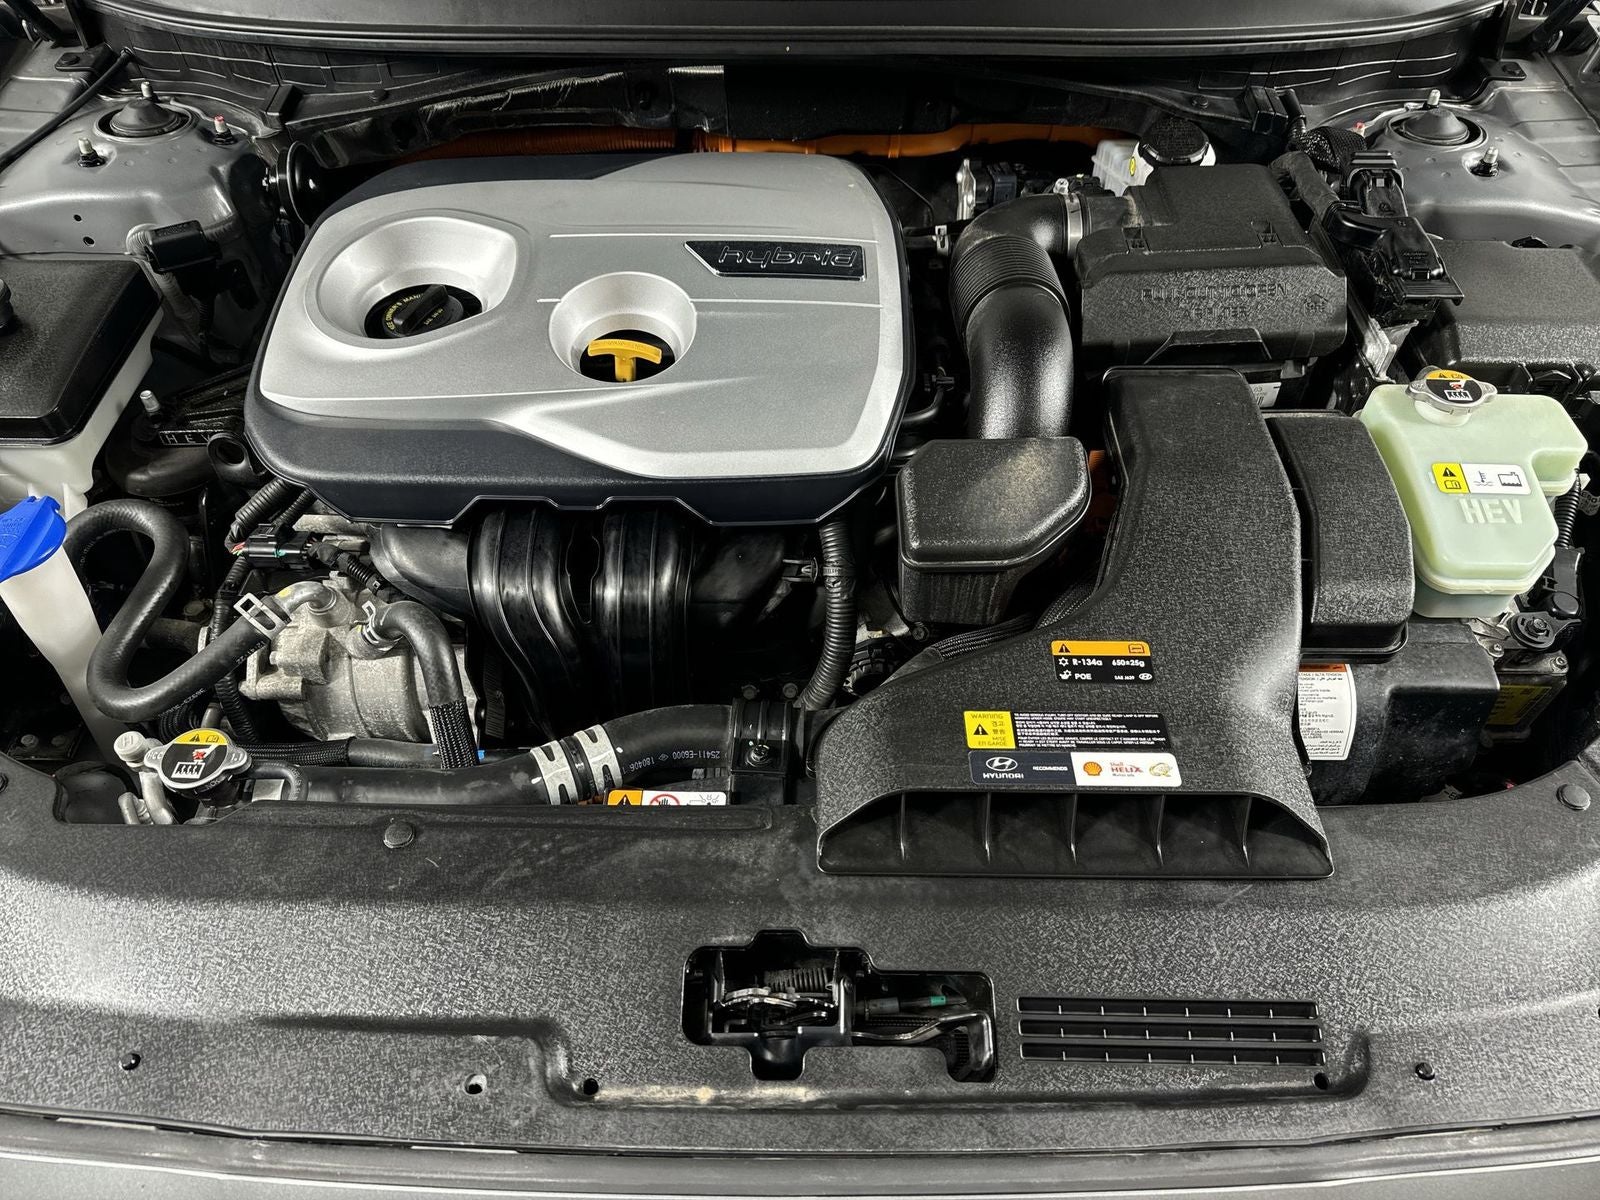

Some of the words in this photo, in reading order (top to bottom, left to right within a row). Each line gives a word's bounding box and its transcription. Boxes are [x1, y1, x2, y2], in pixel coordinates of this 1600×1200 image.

[719, 246, 857, 268] hybrid
[1459, 498, 1523, 524] HEV
[1072, 658, 1103, 666] R-134a
[231, 752, 243, 761] 1.1
